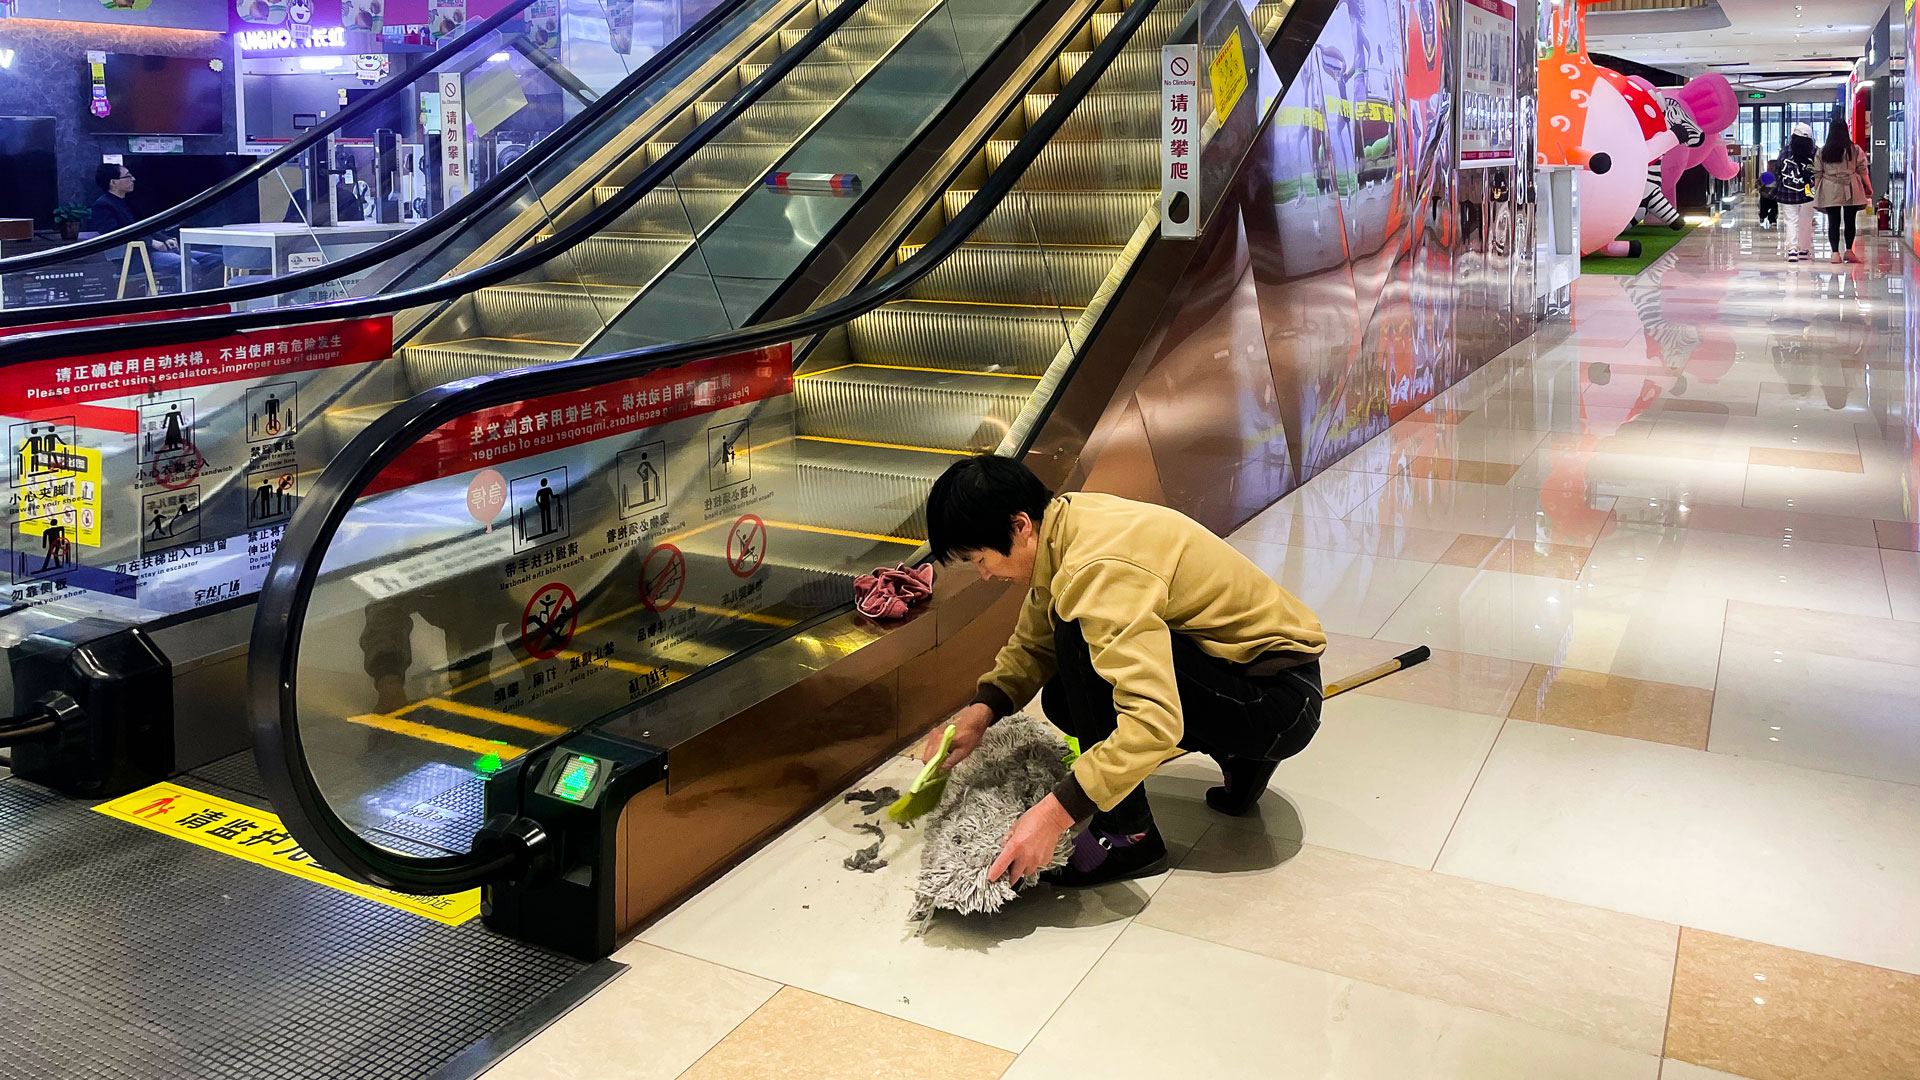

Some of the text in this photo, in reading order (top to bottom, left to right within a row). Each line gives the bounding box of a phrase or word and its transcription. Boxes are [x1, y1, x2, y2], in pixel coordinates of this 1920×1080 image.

[1172, 79, 1196, 87] Climbing
[446, 111, 460, 177] 请勿攀爬
[1170, 93, 1189, 180] 请勿攀爬
[27, 387, 70, 399] Please
[74, 379, 119, 393] correct
[122, 375, 156, 388] using
[273, 357, 292, 367] use
[134, 481, 144, 490] Be
[201, 465, 233, 476] sandwich
[9, 485, 66, 506] 小心夹脚
[43, 500, 61, 510] your
[247, 524, 288, 543] 禁止将
[249, 563, 261, 571] the
[259, 554, 271, 562] not
[140, 571, 156, 580] stay
[157, 568, 165, 576] in
[166, 560, 199, 572] escalator
[63, 589, 87, 598] shoes
[220, 590, 240, 600] PLAZA
[174, 808, 322, 869] 请监护儿
